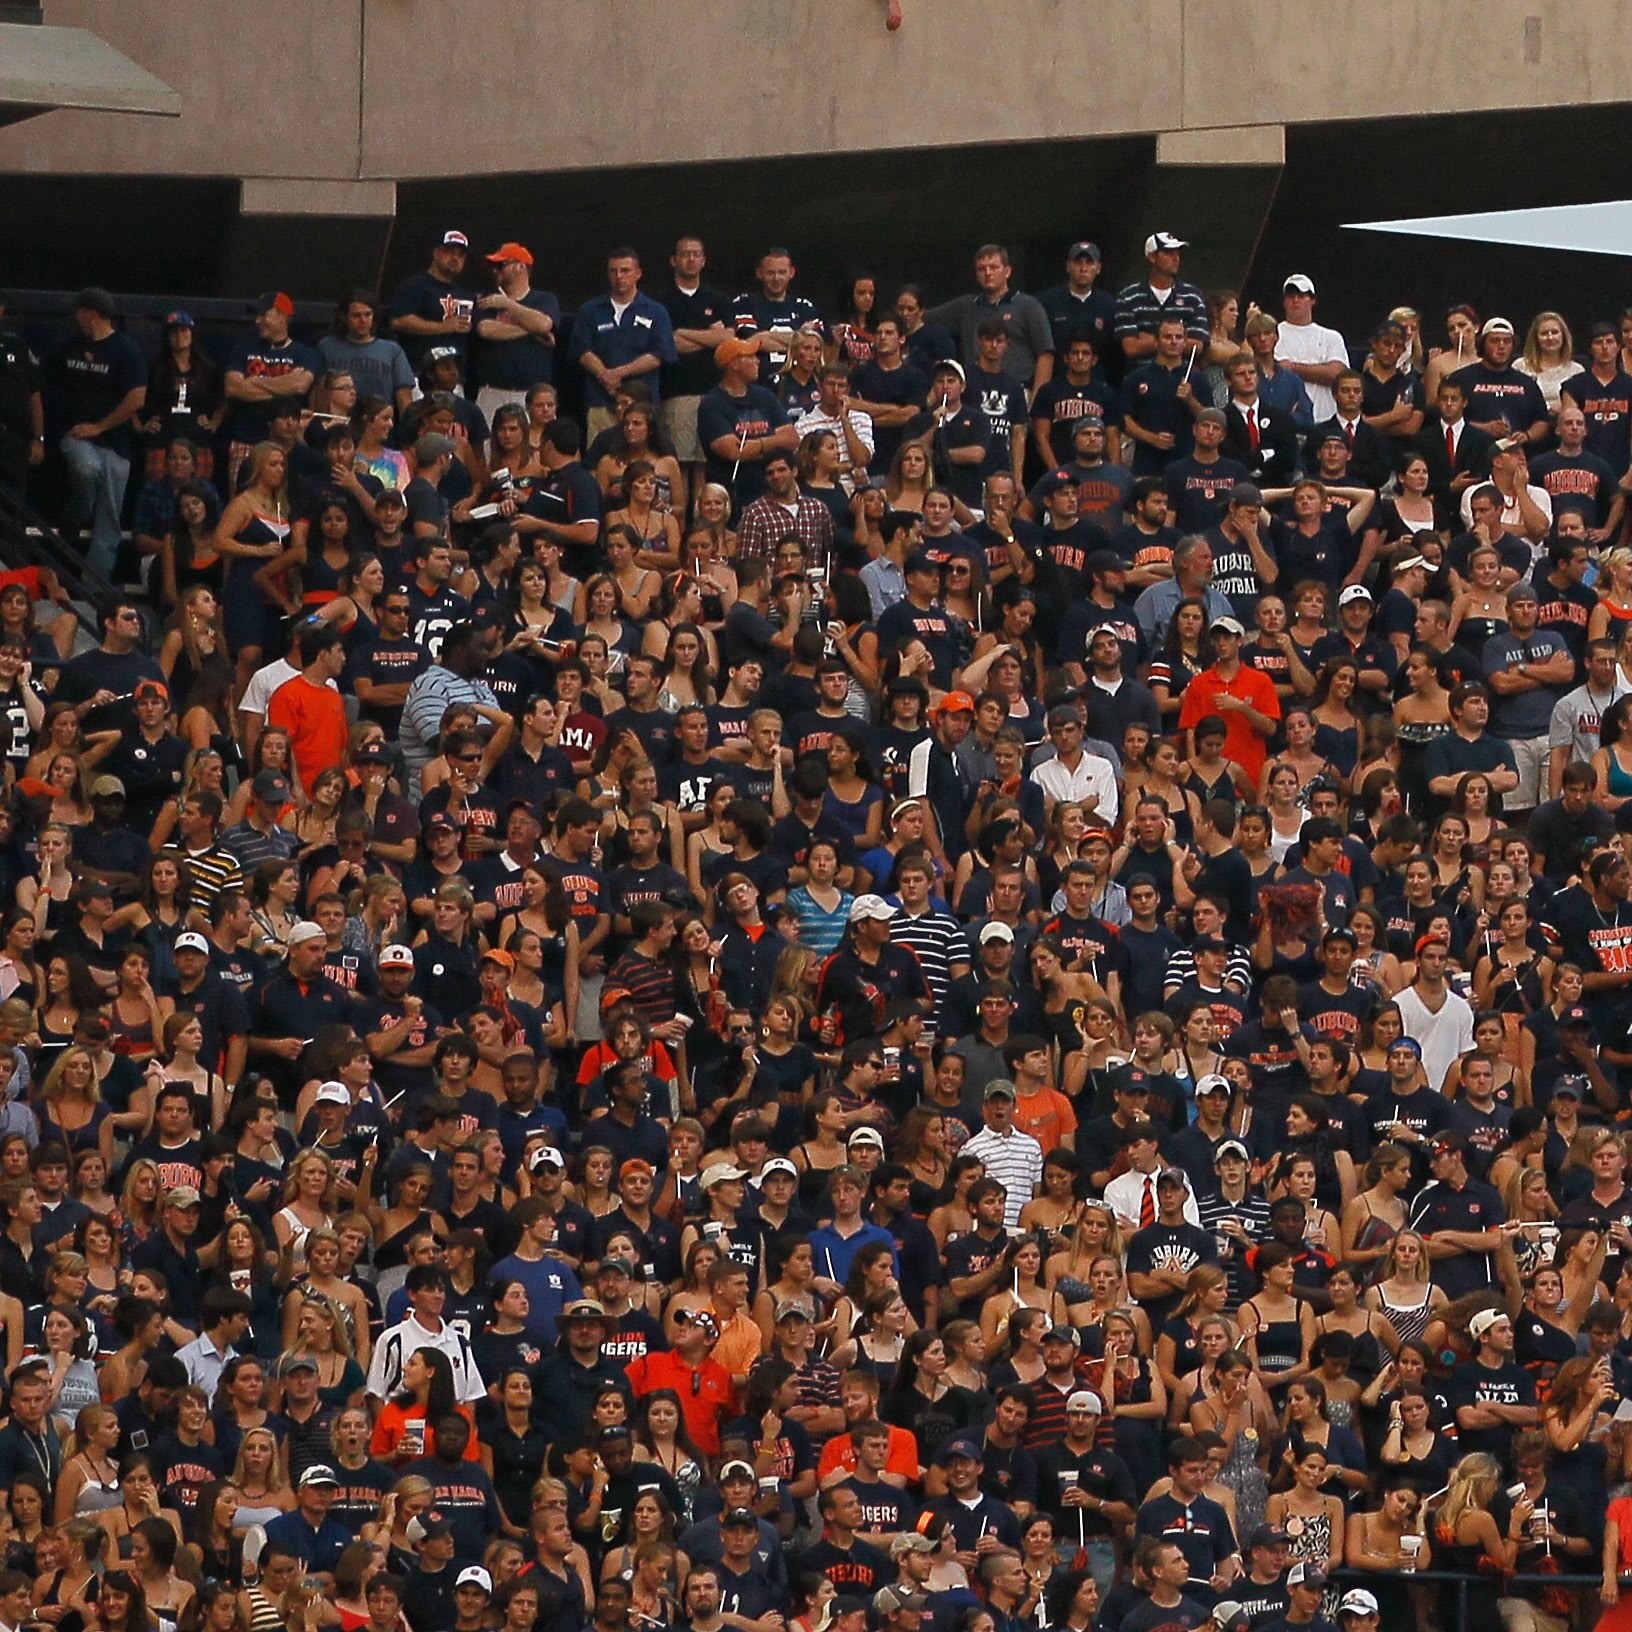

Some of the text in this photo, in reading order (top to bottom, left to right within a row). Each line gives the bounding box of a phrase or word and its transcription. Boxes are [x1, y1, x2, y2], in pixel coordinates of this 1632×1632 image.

[1050, 544, 1086, 572] URN
[1211, 552, 1260, 577] AUBUR
[600, 1340, 647, 1357] IGERS
